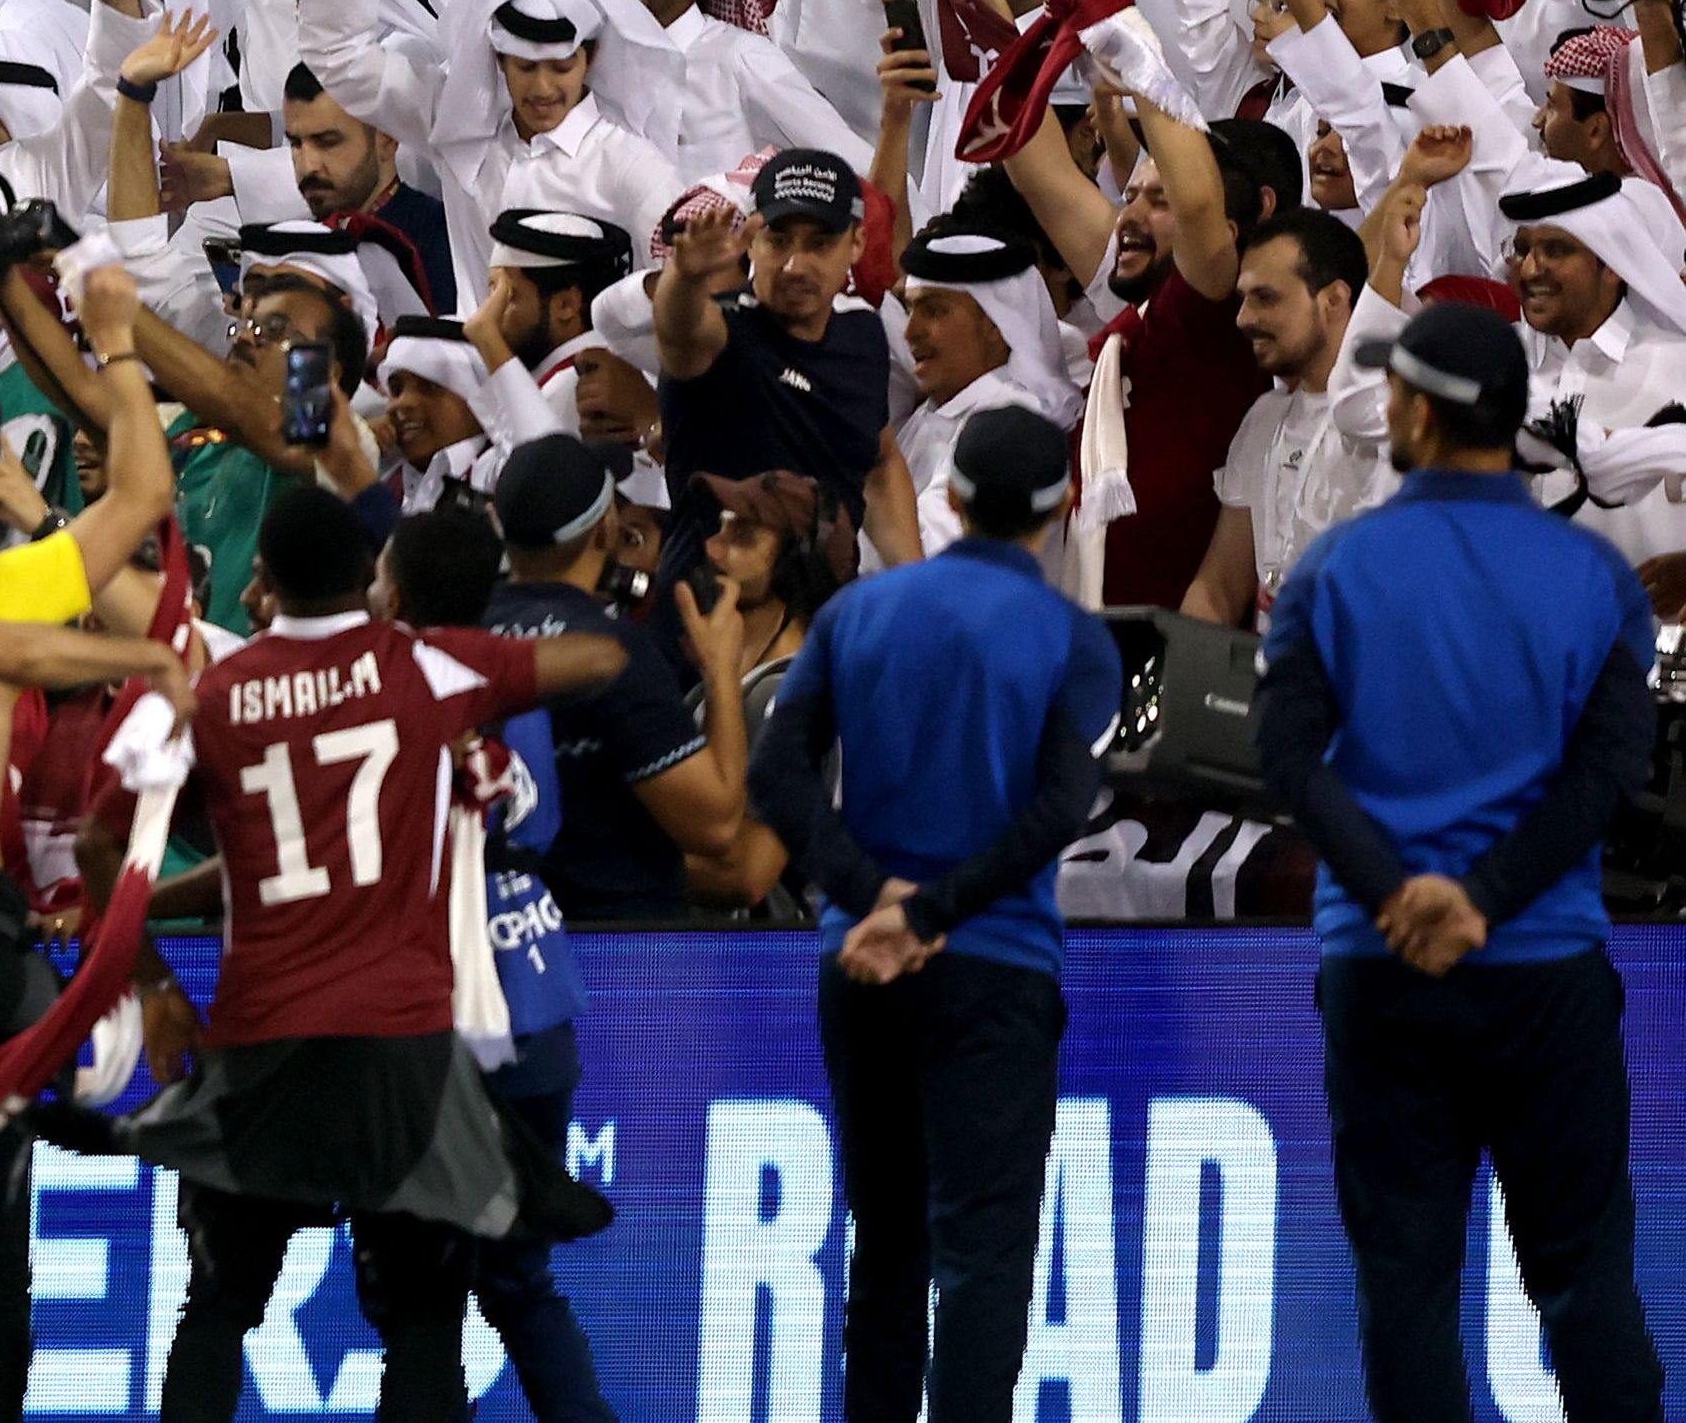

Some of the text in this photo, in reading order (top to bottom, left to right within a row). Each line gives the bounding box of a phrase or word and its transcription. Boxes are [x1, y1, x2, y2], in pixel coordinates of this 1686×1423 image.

[239, 717, 400, 908] 17
[527, 943, 546, 974] 1
[694, 1095, 1279, 1423] RAD
